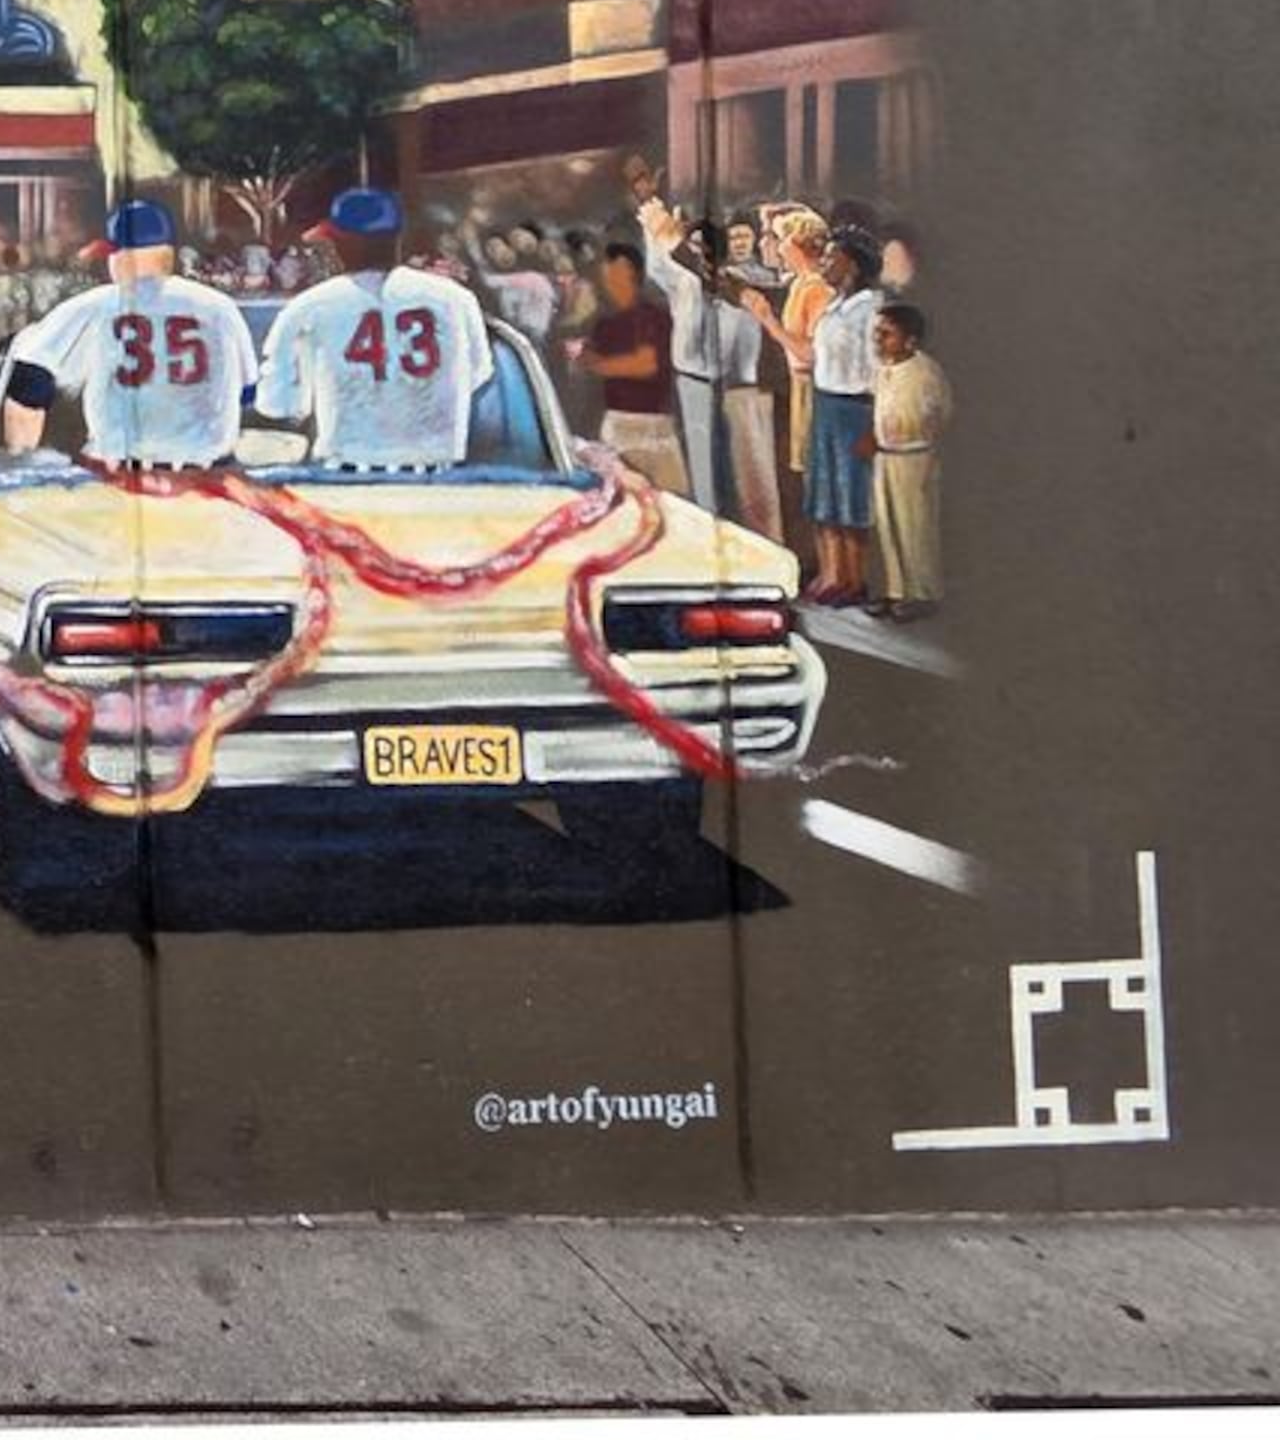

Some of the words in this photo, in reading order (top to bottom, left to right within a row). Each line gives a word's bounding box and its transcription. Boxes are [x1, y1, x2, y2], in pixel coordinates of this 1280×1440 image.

[111, 313, 210, 388] 35
[344, 307, 442, 382] 43
[373, 734, 512, 777] BRAVES1
[473, 1081, 718, 1133] @artofyungai
